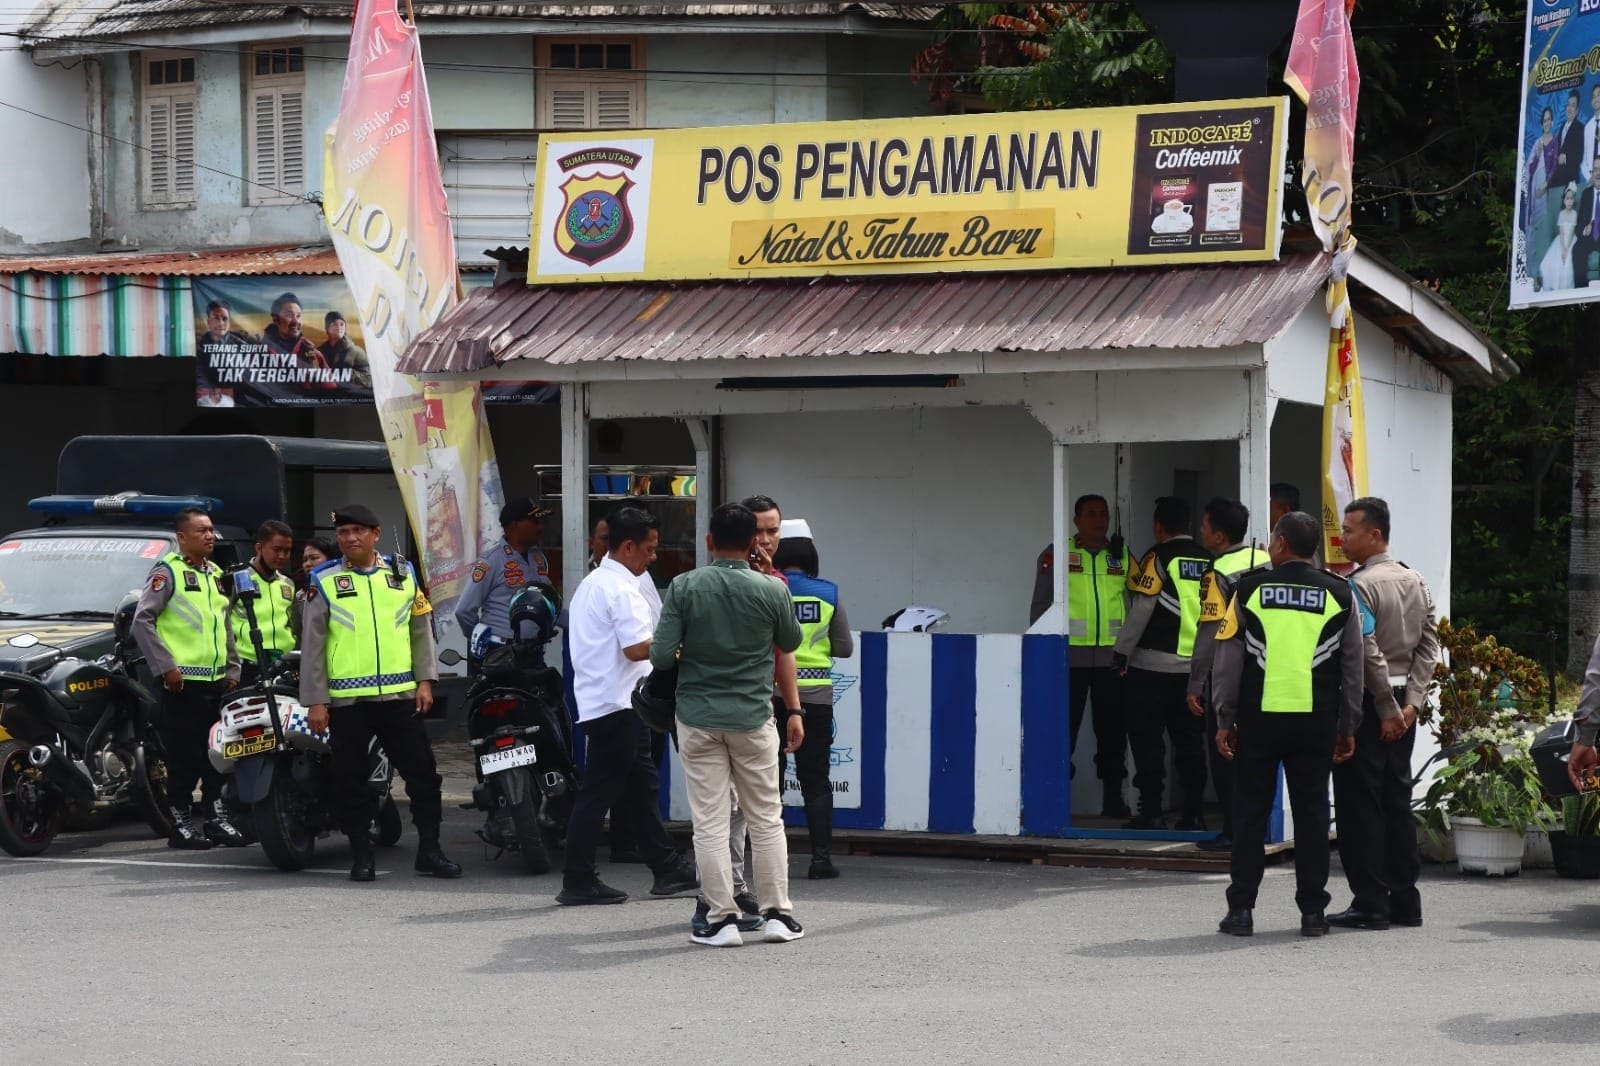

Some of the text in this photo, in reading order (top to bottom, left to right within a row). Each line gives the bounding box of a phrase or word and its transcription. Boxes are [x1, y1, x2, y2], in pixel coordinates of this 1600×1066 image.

[1536, 55, 1587, 86] Selamat
[563, 152, 634, 167] SUMATERA UTARA
[1156, 145, 1242, 169] Coffeemix
[697, 130, 1100, 204] POS PENGAMANAN
[856, 217, 949, 258] Tahun
[949, 215, 1043, 257] Baru
[203, 344, 269, 353] TERANG SURYA
[209, 353, 298, 368] NIKMATNYA
[217, 368, 352, 383] TAK TERGANTIKAN
[97, 541, 144, 553] SELATAN
[1182, 561, 1209, 577] POLI
[1261, 588, 1324, 608] POLISI
[798, 603, 818, 620] ISI
[69, 678, 109, 692] POLISI
